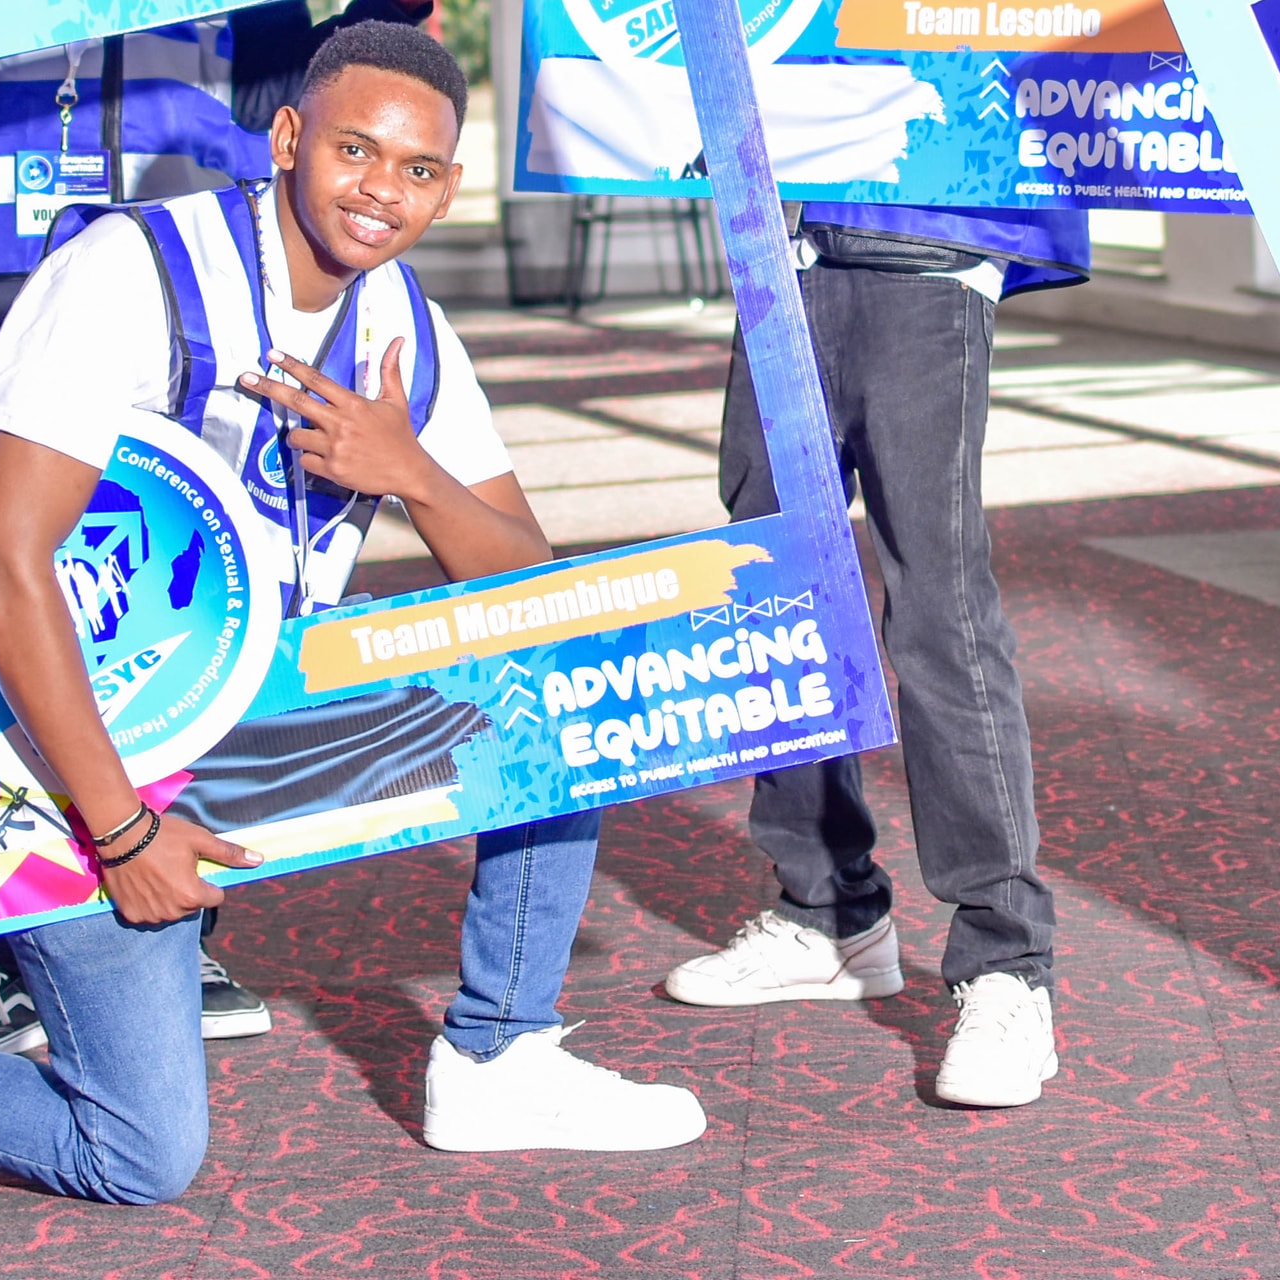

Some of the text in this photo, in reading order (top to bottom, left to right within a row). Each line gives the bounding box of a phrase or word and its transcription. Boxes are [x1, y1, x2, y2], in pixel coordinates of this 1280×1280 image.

[904, 2, 1101, 38] Team Lesotho
[1016, 183, 1054, 195] ACCESS
[1057, 184, 1071, 196] TO
[1114, 186, 1157, 199] HEALTH
[1159, 187, 1185, 199] AND
[117, 446, 204, 509] Conference
[247, 480, 288, 510] Volunte
[202, 508, 222, 531] on
[215, 532, 243, 592] Sexual
[227, 595, 243, 609] &
[351, 567, 679, 664] Team Mozambique
[95, 648, 162, 702] SYC
[167, 614, 241, 718] Reproductive
[570, 777, 618, 799] ACCESS
[618, 773, 637, 788] TO
[686, 754, 737, 774] HEALTH
[739, 745, 769, 763] AND
